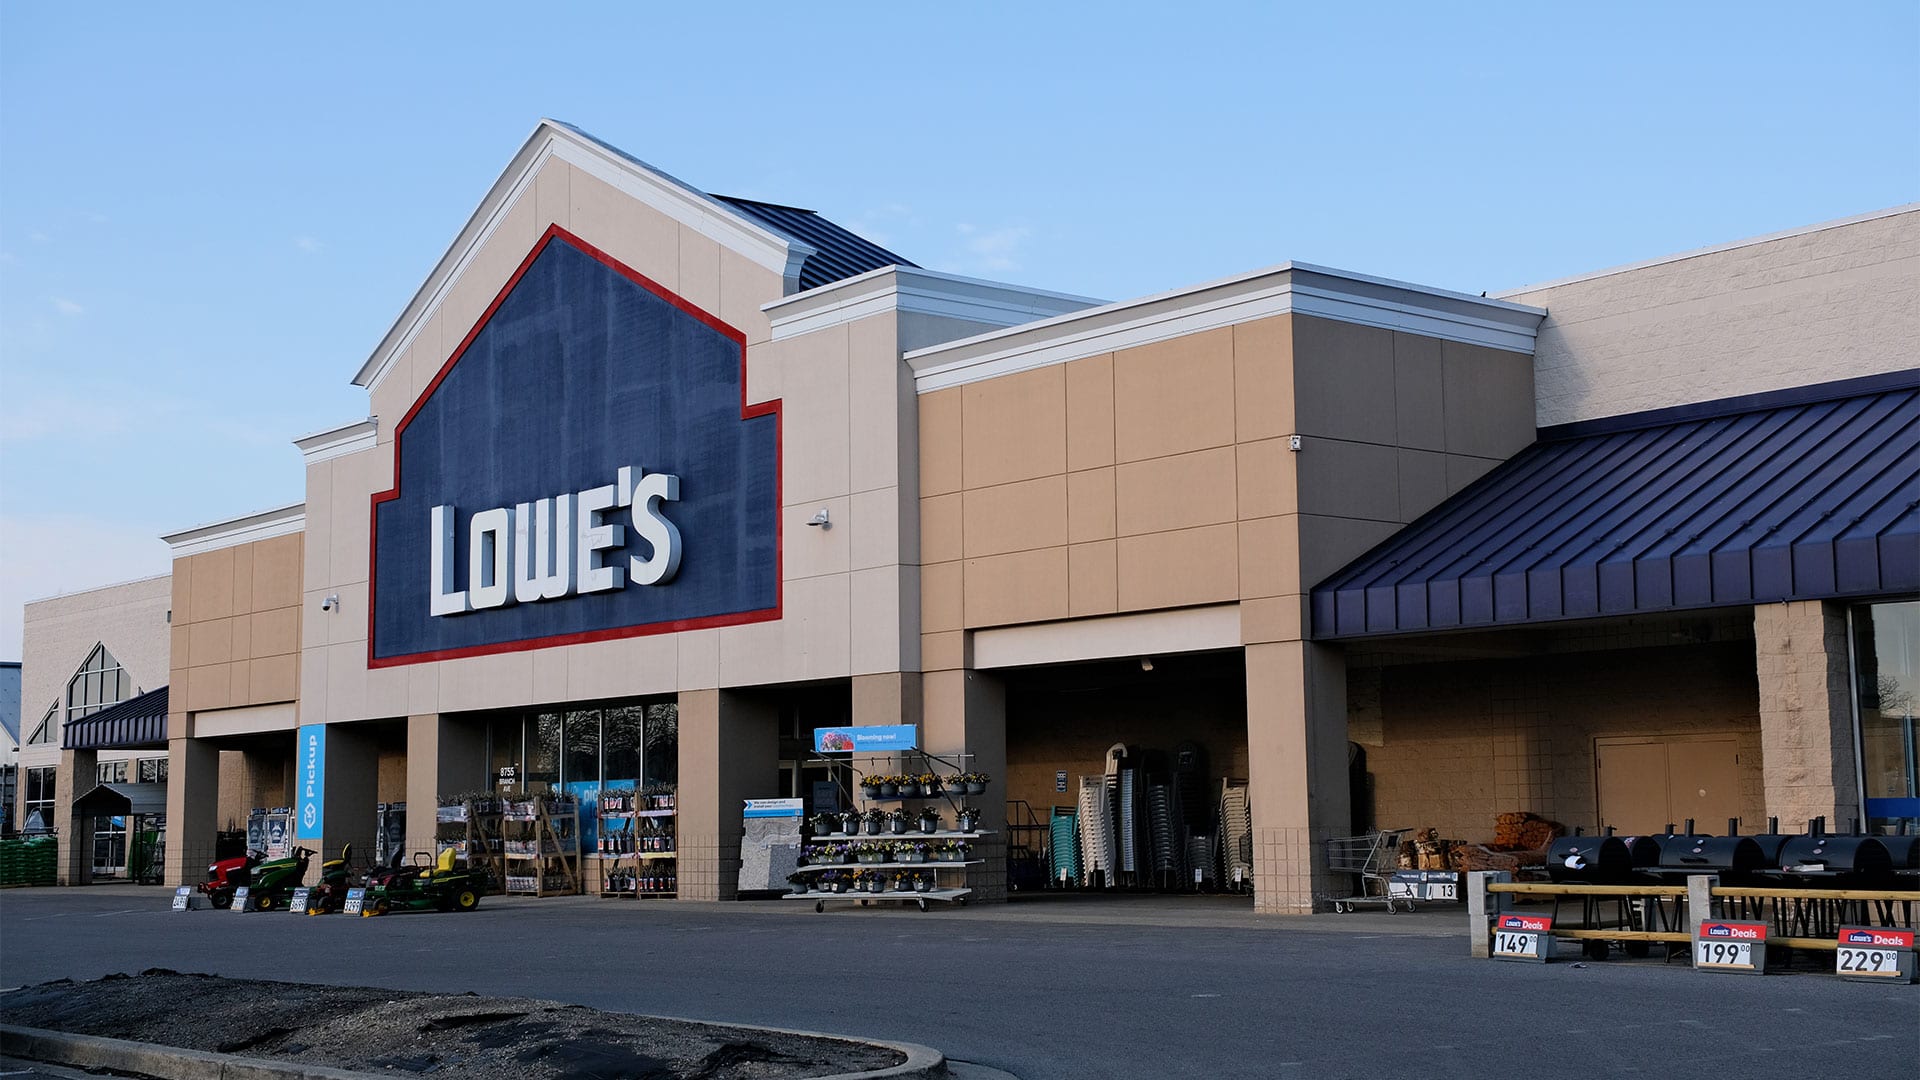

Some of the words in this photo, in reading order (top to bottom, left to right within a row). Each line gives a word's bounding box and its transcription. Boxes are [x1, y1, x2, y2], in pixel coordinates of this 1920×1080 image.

[430, 465, 682, 617] LOWE'S
[857, 734, 882, 742] Blooming
[306, 735, 317, 798] Pickup
[499, 767, 514, 777] 8755
[1522, 920, 1543, 930] Deals
[1731, 928, 1757, 938] Deals
[1874, 935, 1904, 945] Deals
